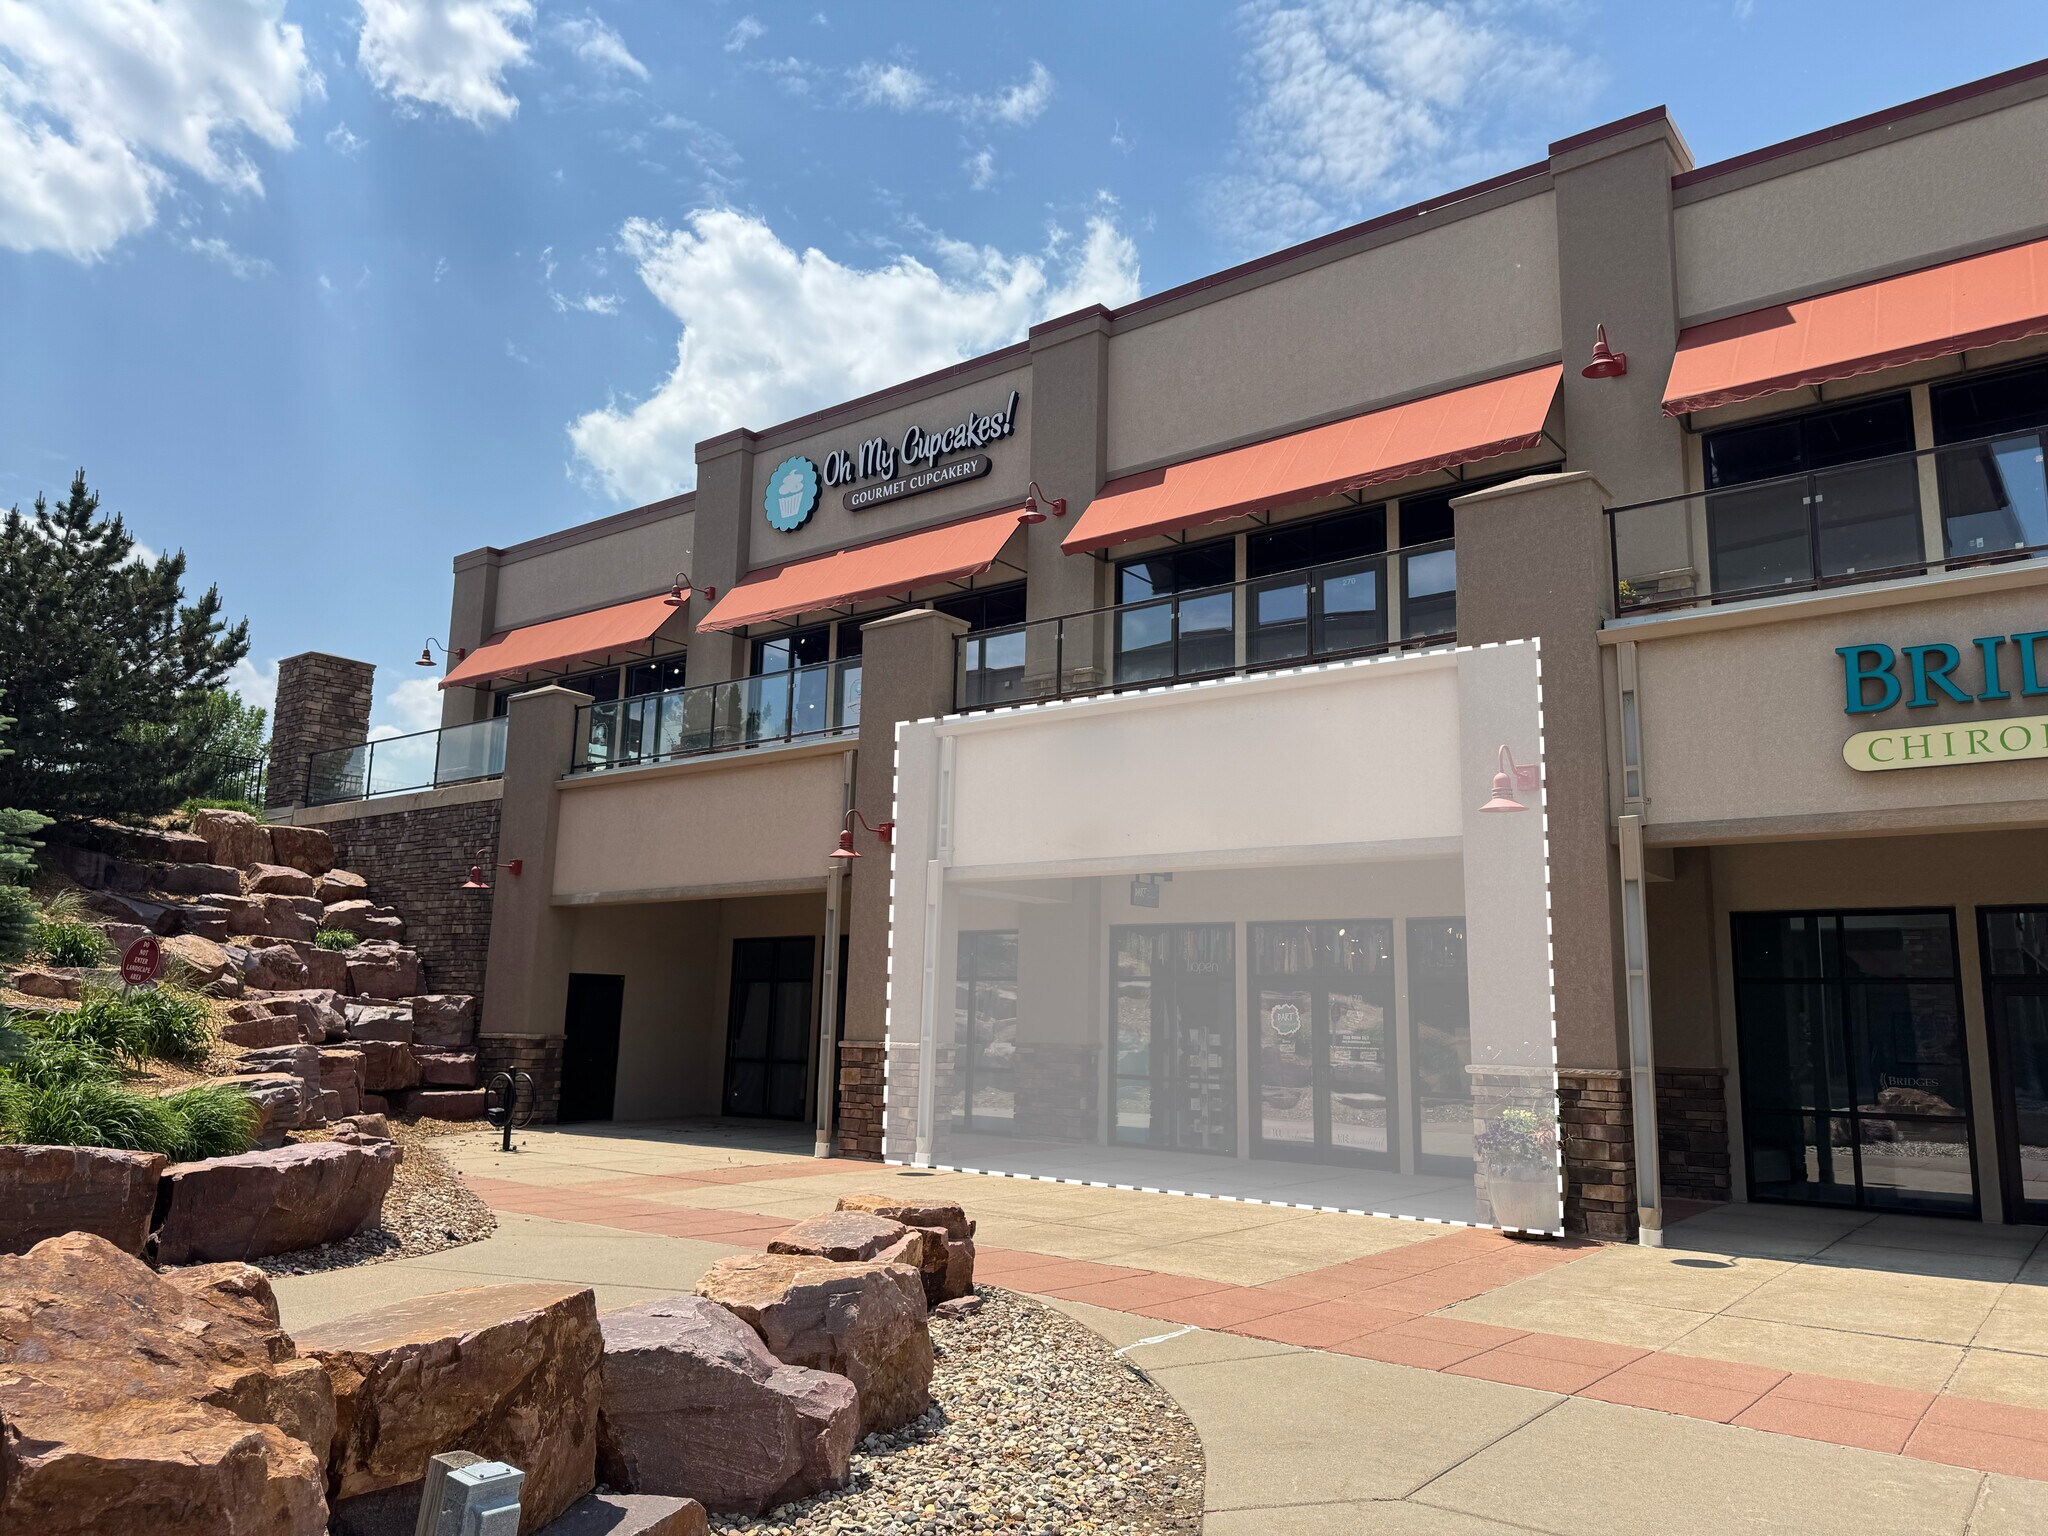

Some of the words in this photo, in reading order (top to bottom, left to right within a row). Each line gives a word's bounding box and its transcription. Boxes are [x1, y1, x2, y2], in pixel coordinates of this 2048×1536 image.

[823, 449, 855, 487] Oh
[859, 437, 898, 480] My
[901, 390, 1019, 467] Cupcakes!
[851, 480, 906, 505] GOURMET
[909, 459, 978, 490] CUPCAKERY
[1343, 578, 1356, 586] 270
[134, 957, 149, 965] ENTER
[126, 964, 151, 974] LANDSCAPE
[1889, 1076, 1940, 1087] BRIDGES
